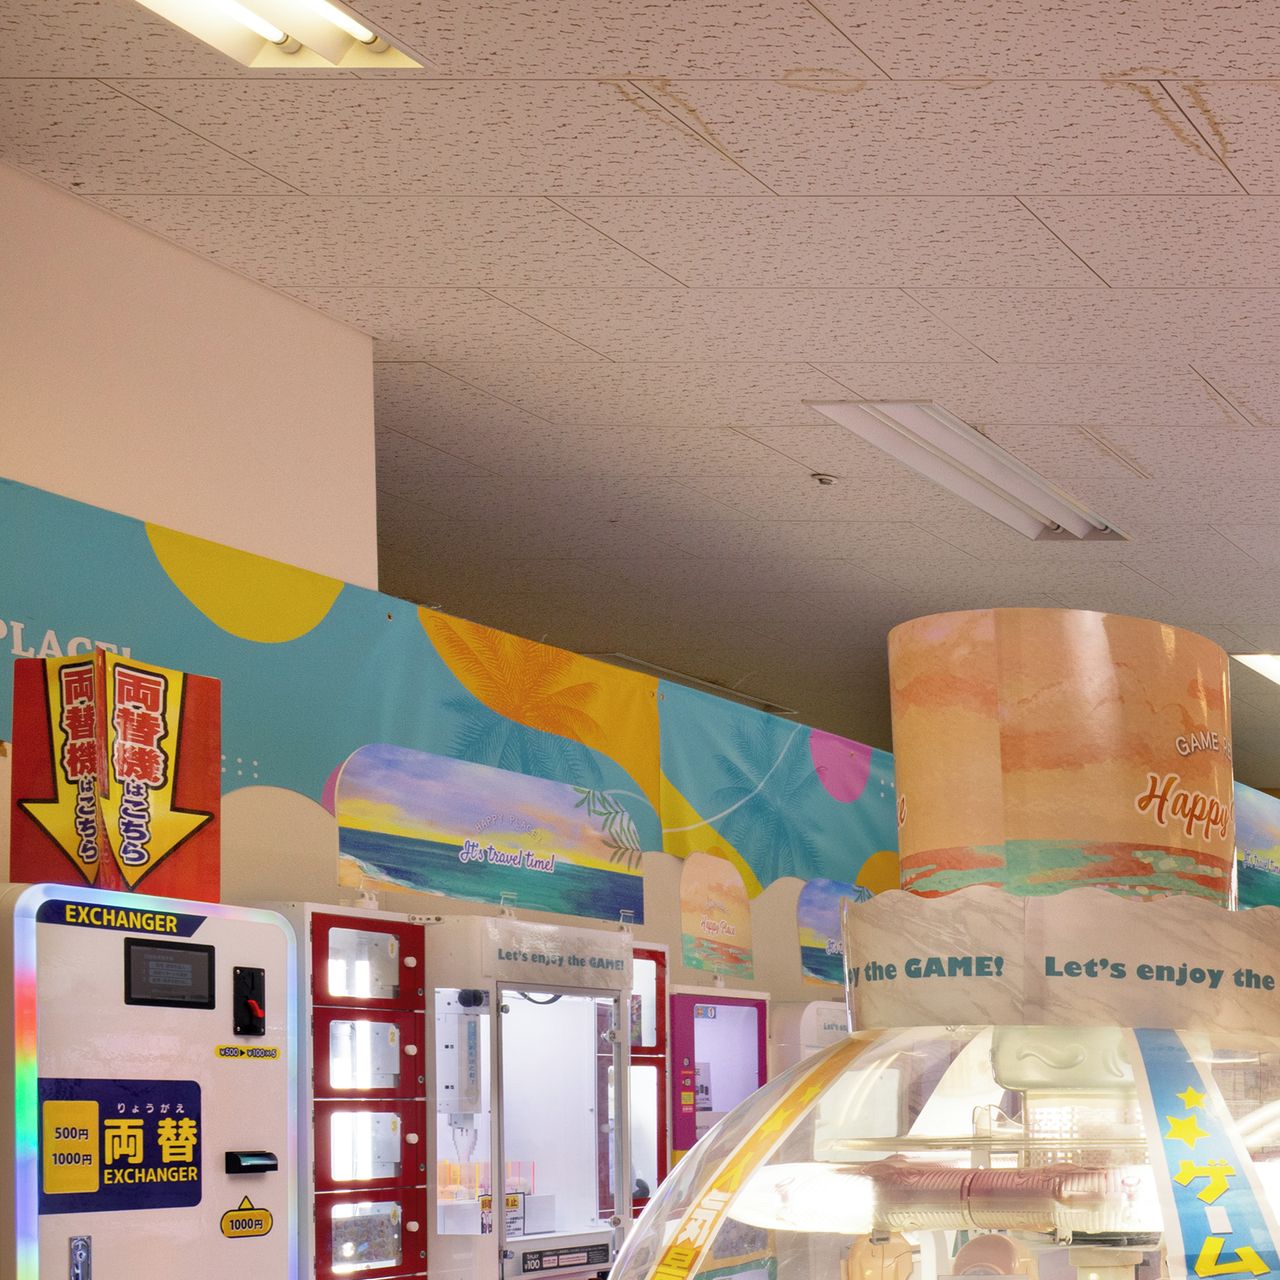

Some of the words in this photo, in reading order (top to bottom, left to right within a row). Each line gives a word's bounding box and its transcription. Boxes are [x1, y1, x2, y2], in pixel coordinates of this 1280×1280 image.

[1175, 731, 1219, 757] GAME
[113, 666, 166, 864] 両替機はこちら
[1137, 774, 1230, 839] Happy
[459, 840, 486, 863] It's
[487, 844, 524, 868] travel
[524, 850, 556, 873] time!
[65, 904, 178, 933] EXCHANGER
[497, 948, 530, 962] Let's
[530, 950, 565, 967] enjoy
[567, 952, 587, 968] the
[588, 953, 625, 971] GAME!
[864, 957, 899, 981] the
[904, 956, 1005, 980] GAME!
[1044, 956, 1126, 980] Let's
[1136, 963, 1224, 991] enjoy
[1233, 967, 1275, 991] the
[116, 1102, 186, 1115] りょうがえ
[54, 1126, 90, 1140] 500円
[103, 1117, 198, 1166] 両替
[51, 1152, 93, 1166] 1000円
[103, 1166, 198, 1185] EXCHANGER
[229, 1218, 264, 1232] 1000円
